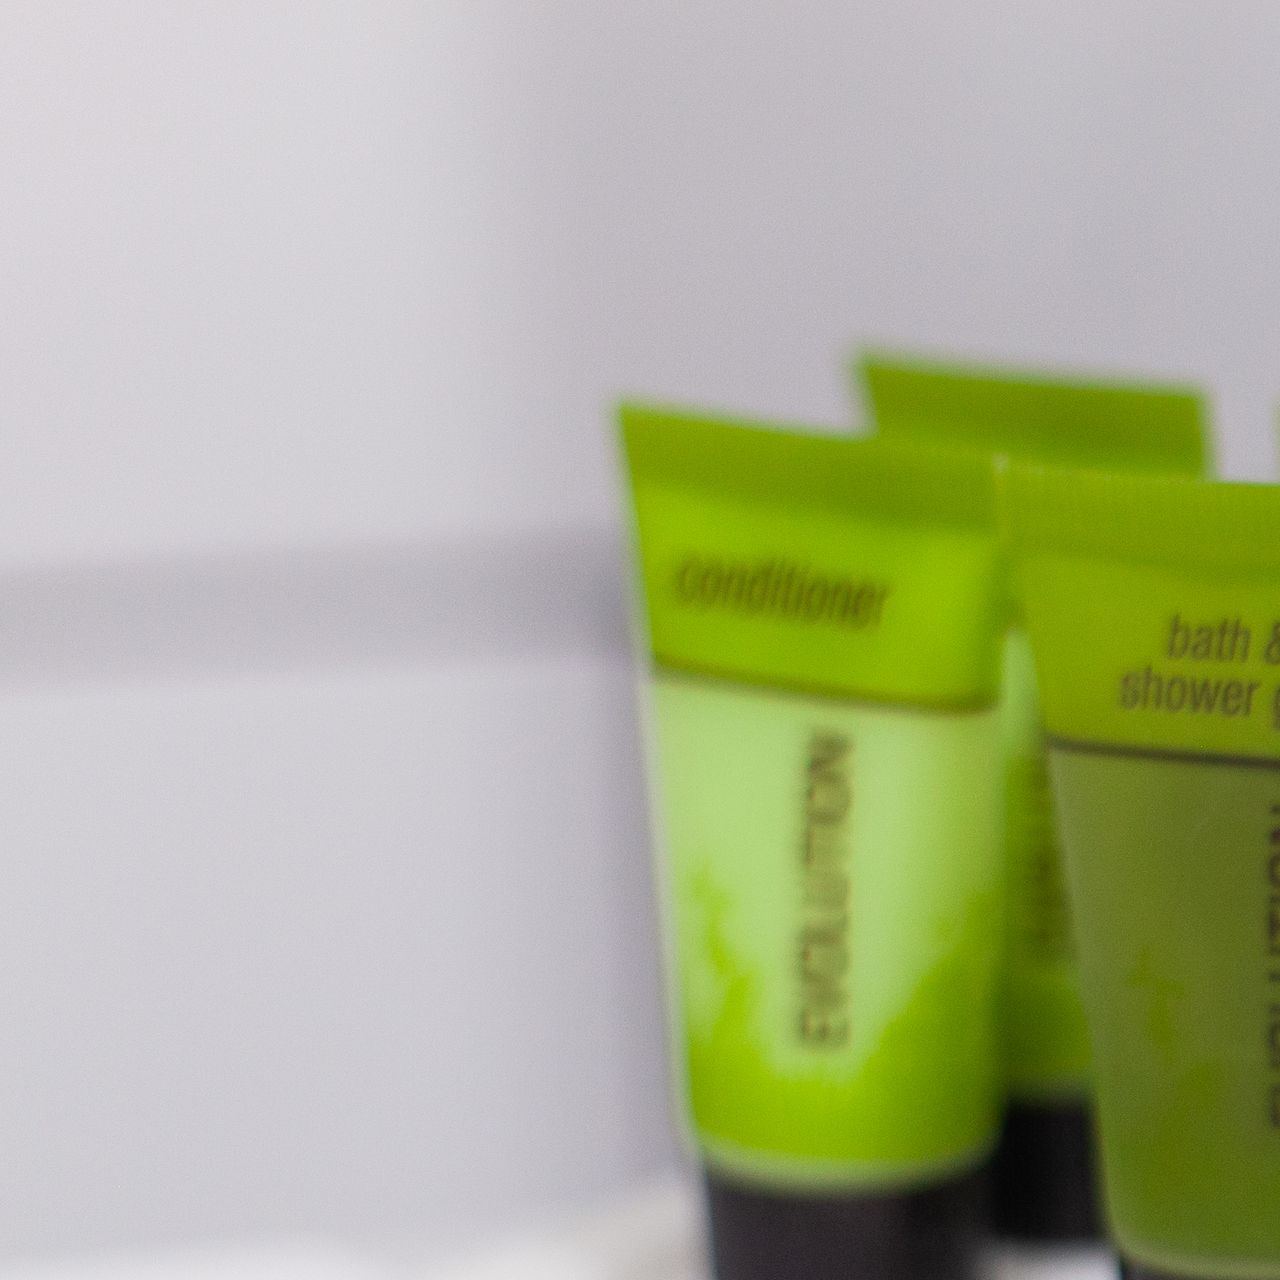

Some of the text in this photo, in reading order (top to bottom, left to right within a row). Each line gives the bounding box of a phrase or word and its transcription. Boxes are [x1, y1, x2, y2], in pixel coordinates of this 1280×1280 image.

[672, 556, 891, 628] conditioner
[1167, 615, 1251, 662] bath
[1119, 663, 1260, 721] shower
[798, 731, 853, 1052] EVOLUTION
